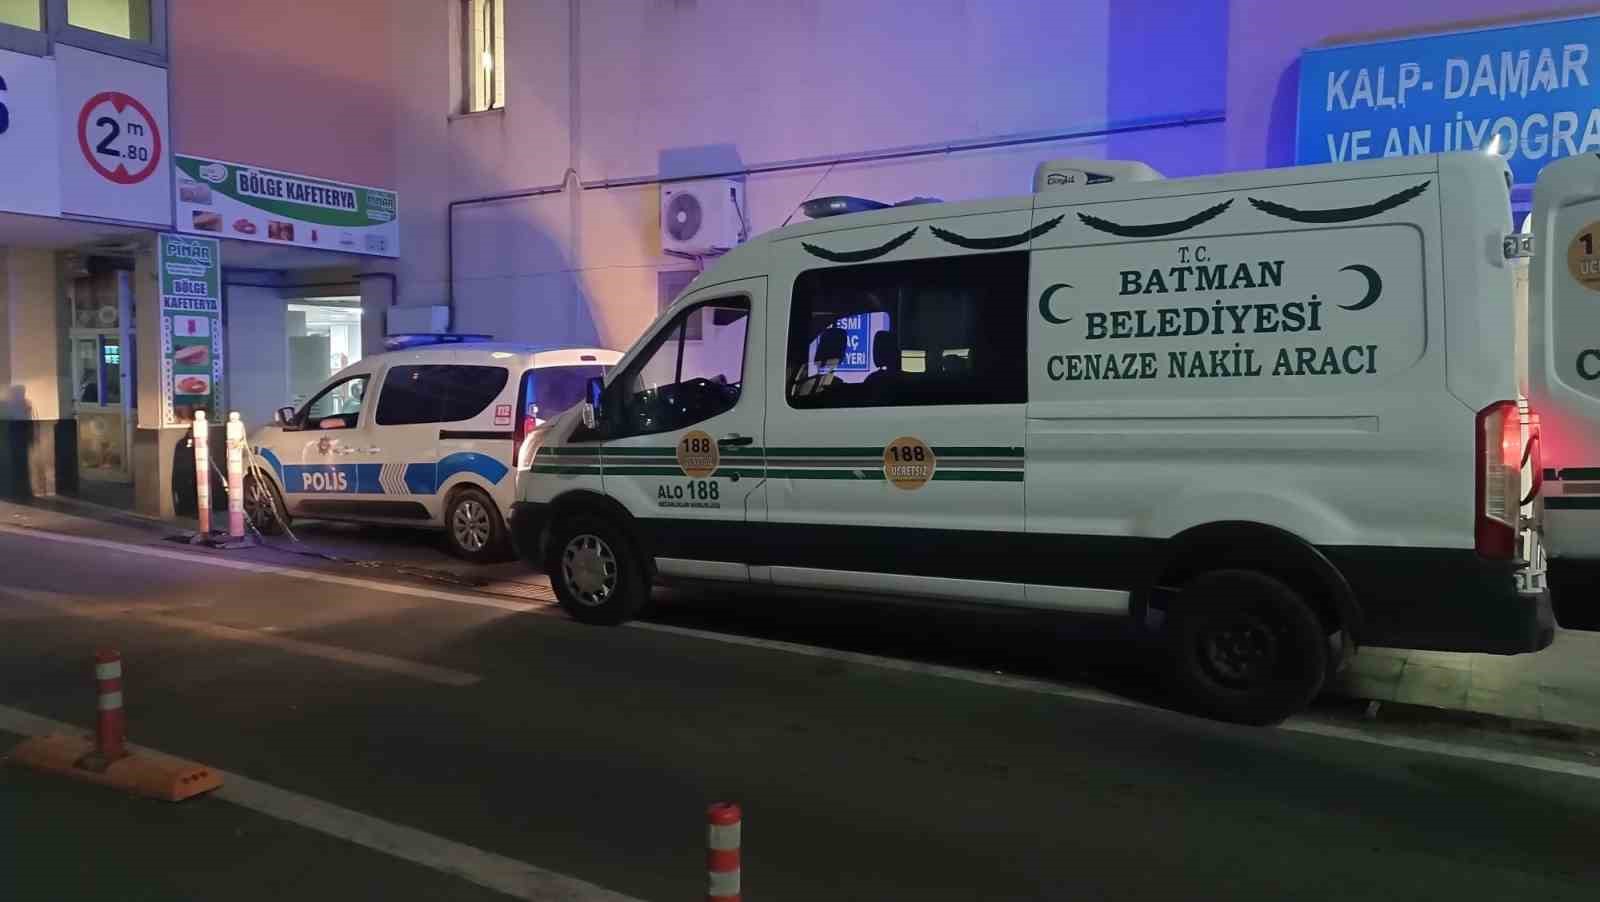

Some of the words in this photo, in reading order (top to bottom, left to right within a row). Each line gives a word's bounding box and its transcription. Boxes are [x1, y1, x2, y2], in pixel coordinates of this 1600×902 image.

[1444, 43, 1590, 101] DAMAR
[1327, 130, 1371, 164] VE
[239, 173, 284, 197] BÖLGE
[286, 180, 356, 209] KAFETERYA
[175, 279, 207, 294] BÖLGE
[1119, 260, 1285, 296] BATMAN
[164, 296, 217, 310] KAFETERYA
[837, 314, 862, 330] ESMİ
[1085, 294, 1322, 340] BELEDİYESİ
[1047, 352, 1158, 381] CENAZE
[1167, 342, 1262, 379] NAKİL
[1272, 345, 1378, 377] ARACI
[682, 438, 711, 453] 188
[890, 446, 925, 461] 188
[302, 467, 348, 491] POLİS
[658, 485, 683, 499] ALO
[687, 480, 719, 500] 188
